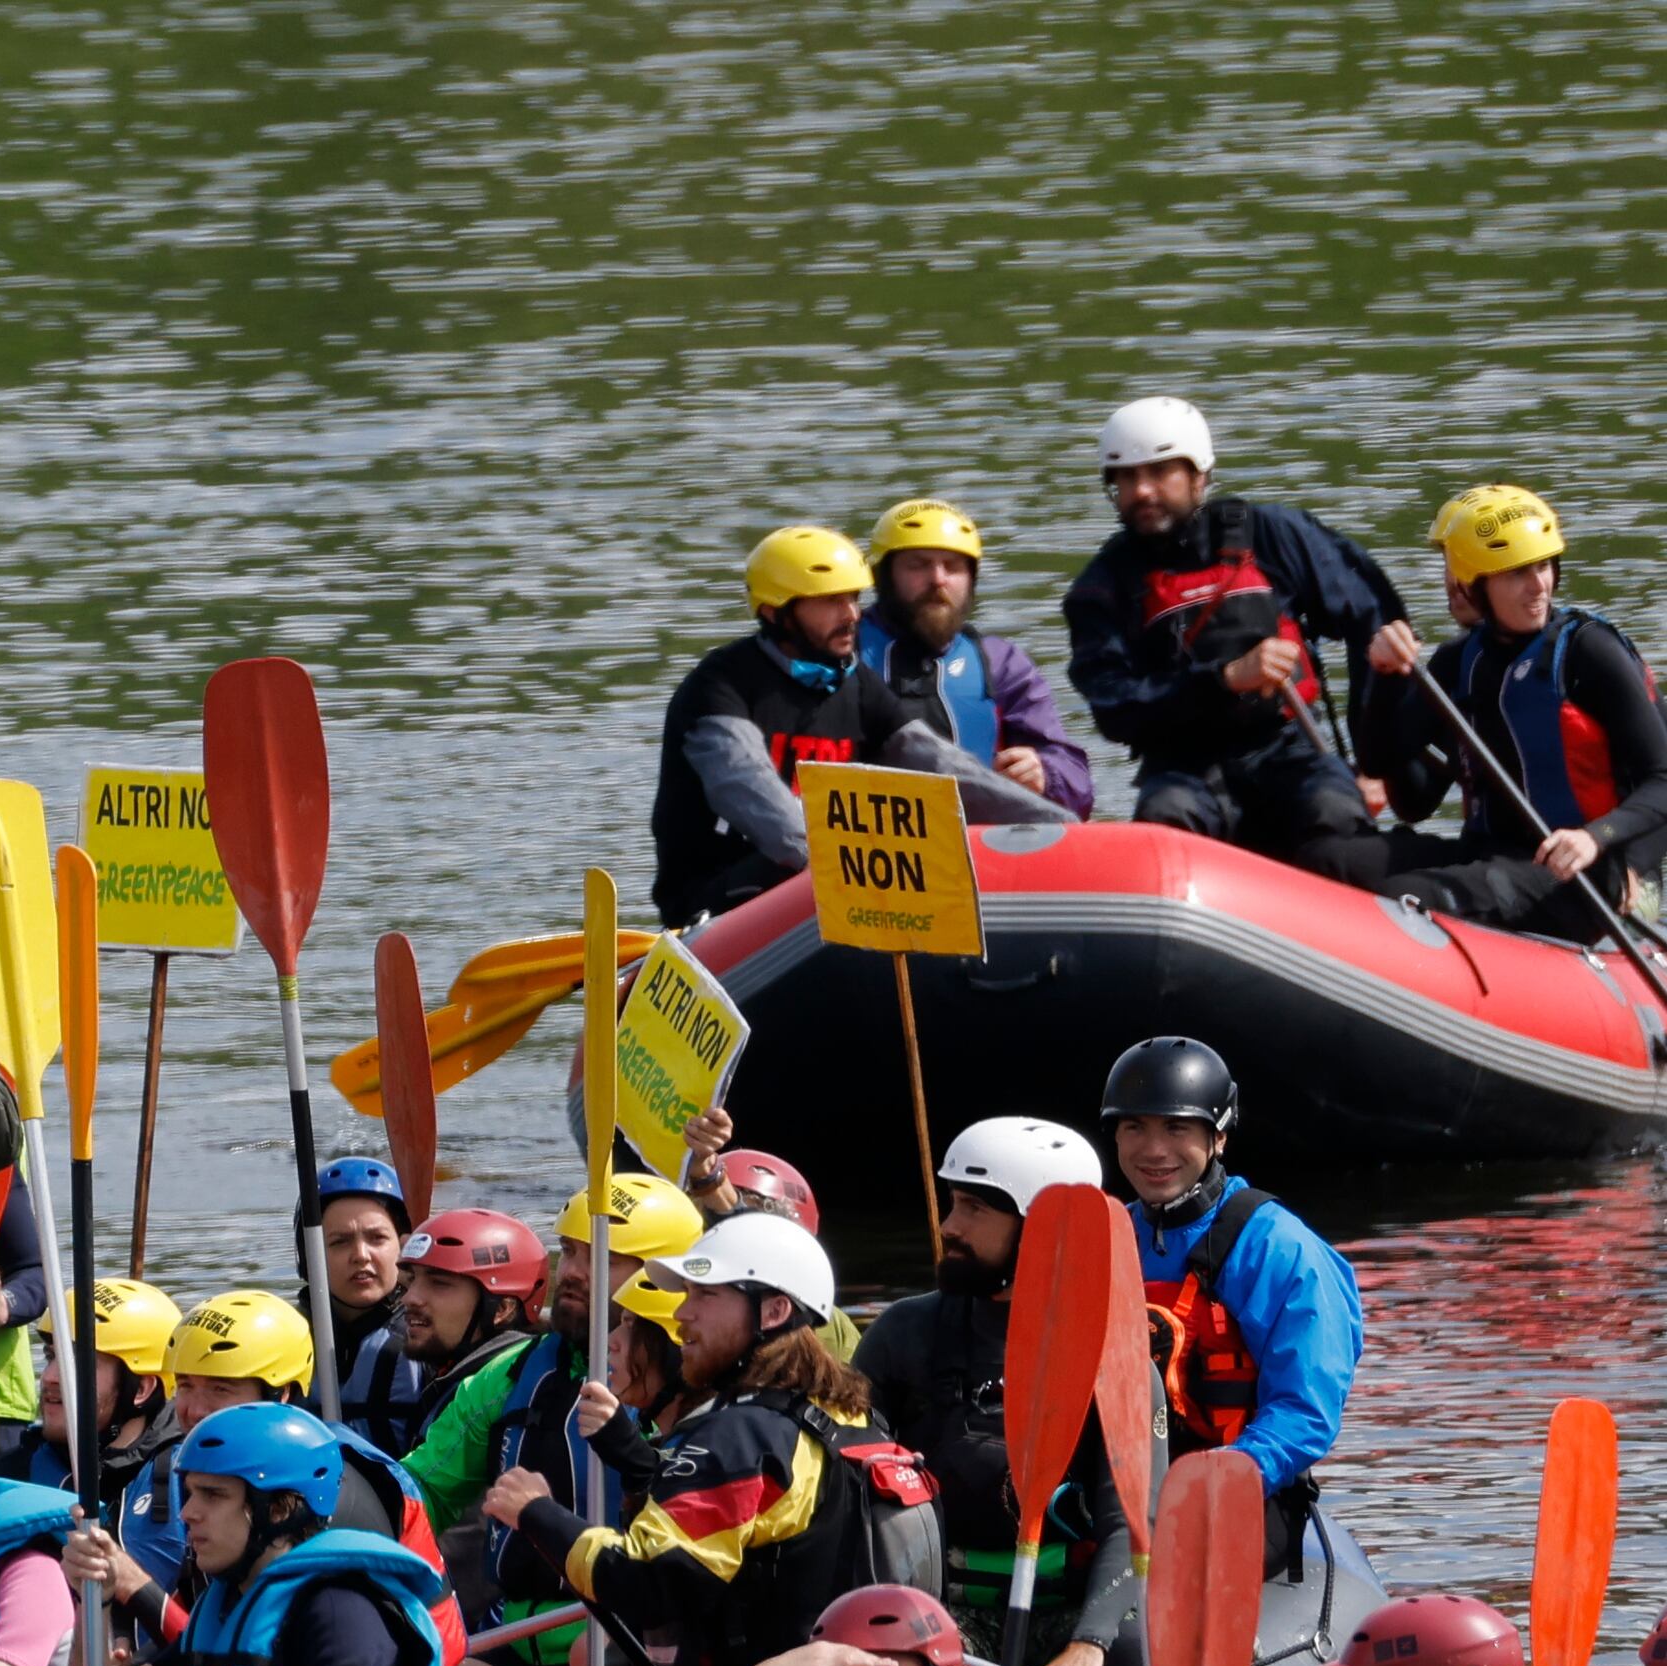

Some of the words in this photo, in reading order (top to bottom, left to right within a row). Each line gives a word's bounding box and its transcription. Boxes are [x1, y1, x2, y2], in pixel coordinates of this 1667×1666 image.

[96, 783, 169, 830] ALTRI
[179, 785, 213, 831] NO
[827, 788, 929, 839] ALTRI
[95, 862, 225, 907] GREENPEACE
[839, 844, 927, 894] NON
[846, 904, 935, 932] GREENPEACE
[643, 959, 693, 1042] ALTRI
[691, 1012, 732, 1074] NON
[617, 1027, 701, 1136] GREENPEACE
